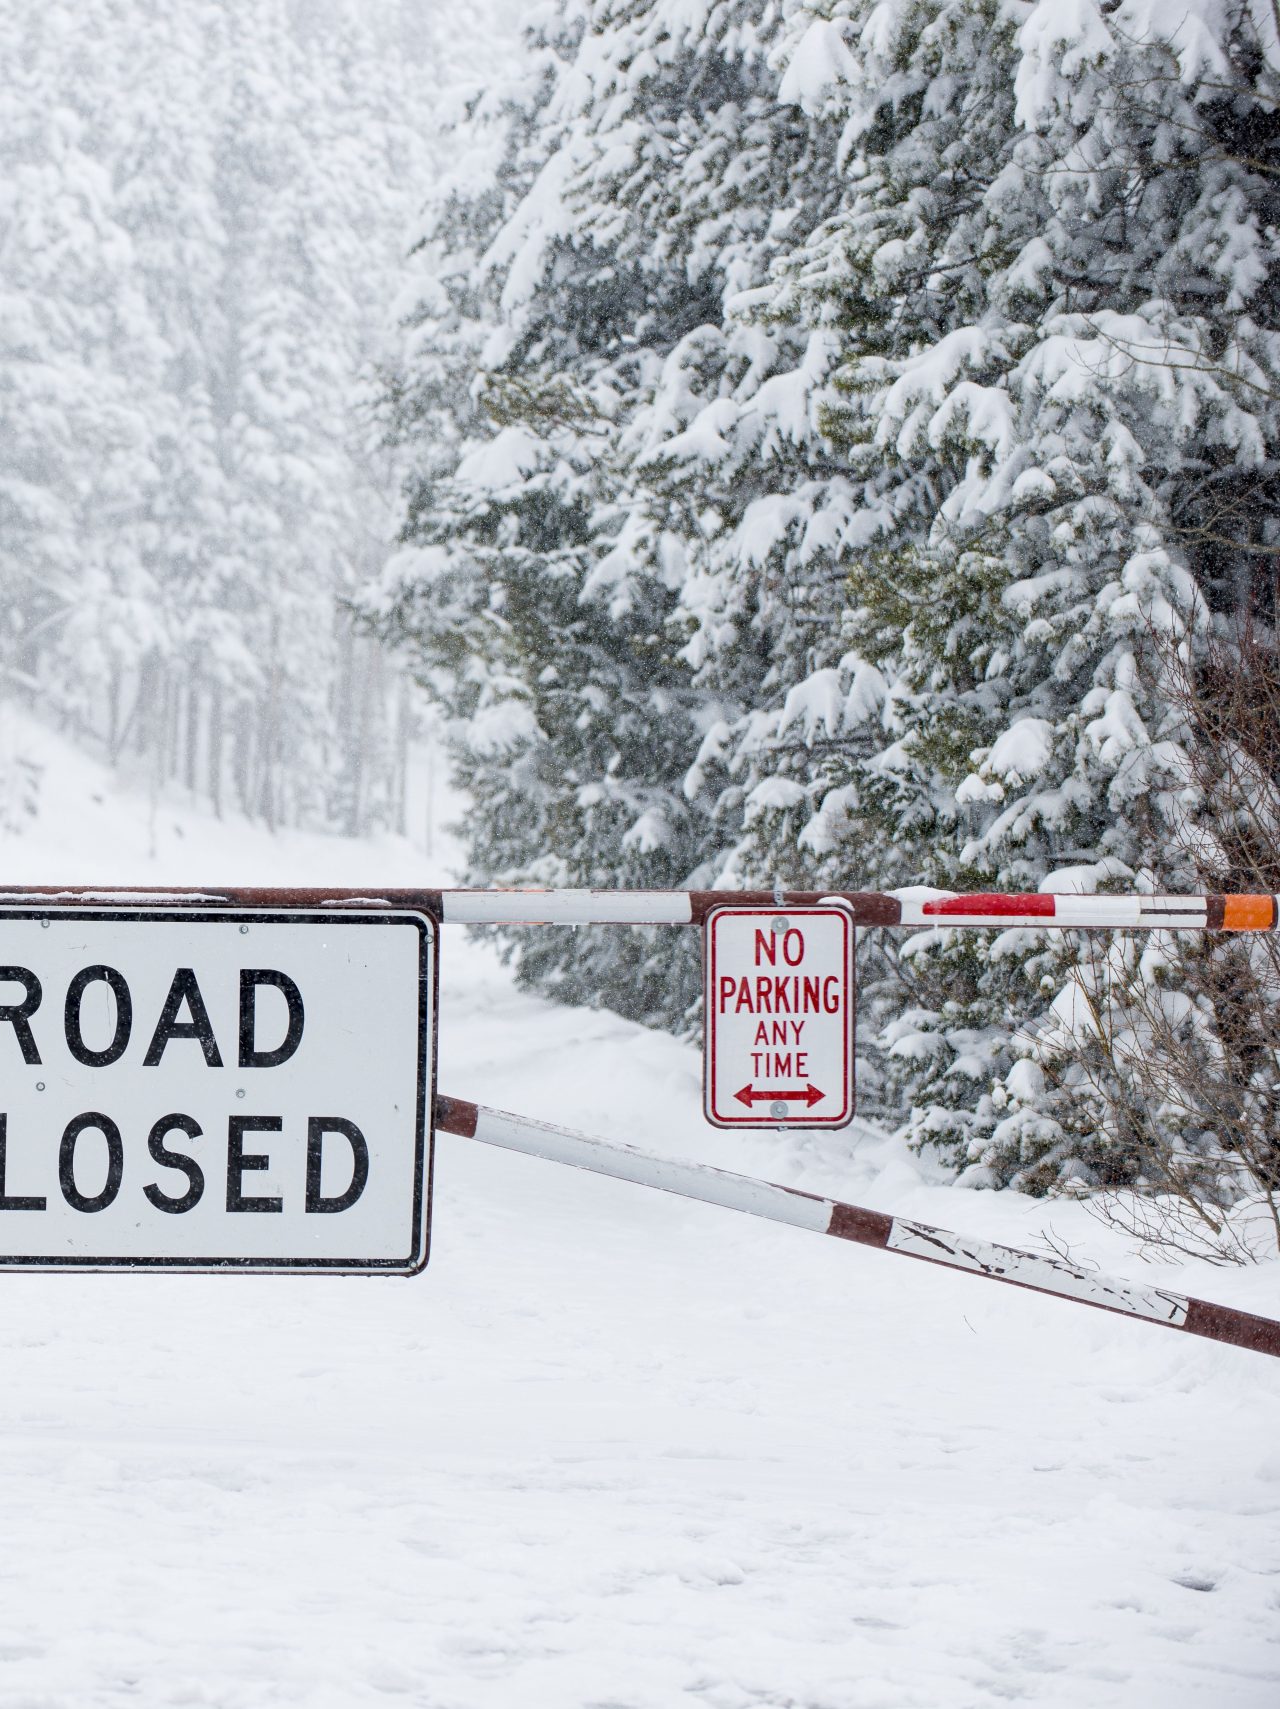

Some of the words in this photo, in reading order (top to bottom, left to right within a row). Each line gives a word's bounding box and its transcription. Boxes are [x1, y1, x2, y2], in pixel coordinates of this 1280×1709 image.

[755, 928, 805, 967] NO
[720, 975, 839, 1014] PARKING
[754, 1020, 806, 1046] ANY
[750, 1052, 809, 1078] TIME
